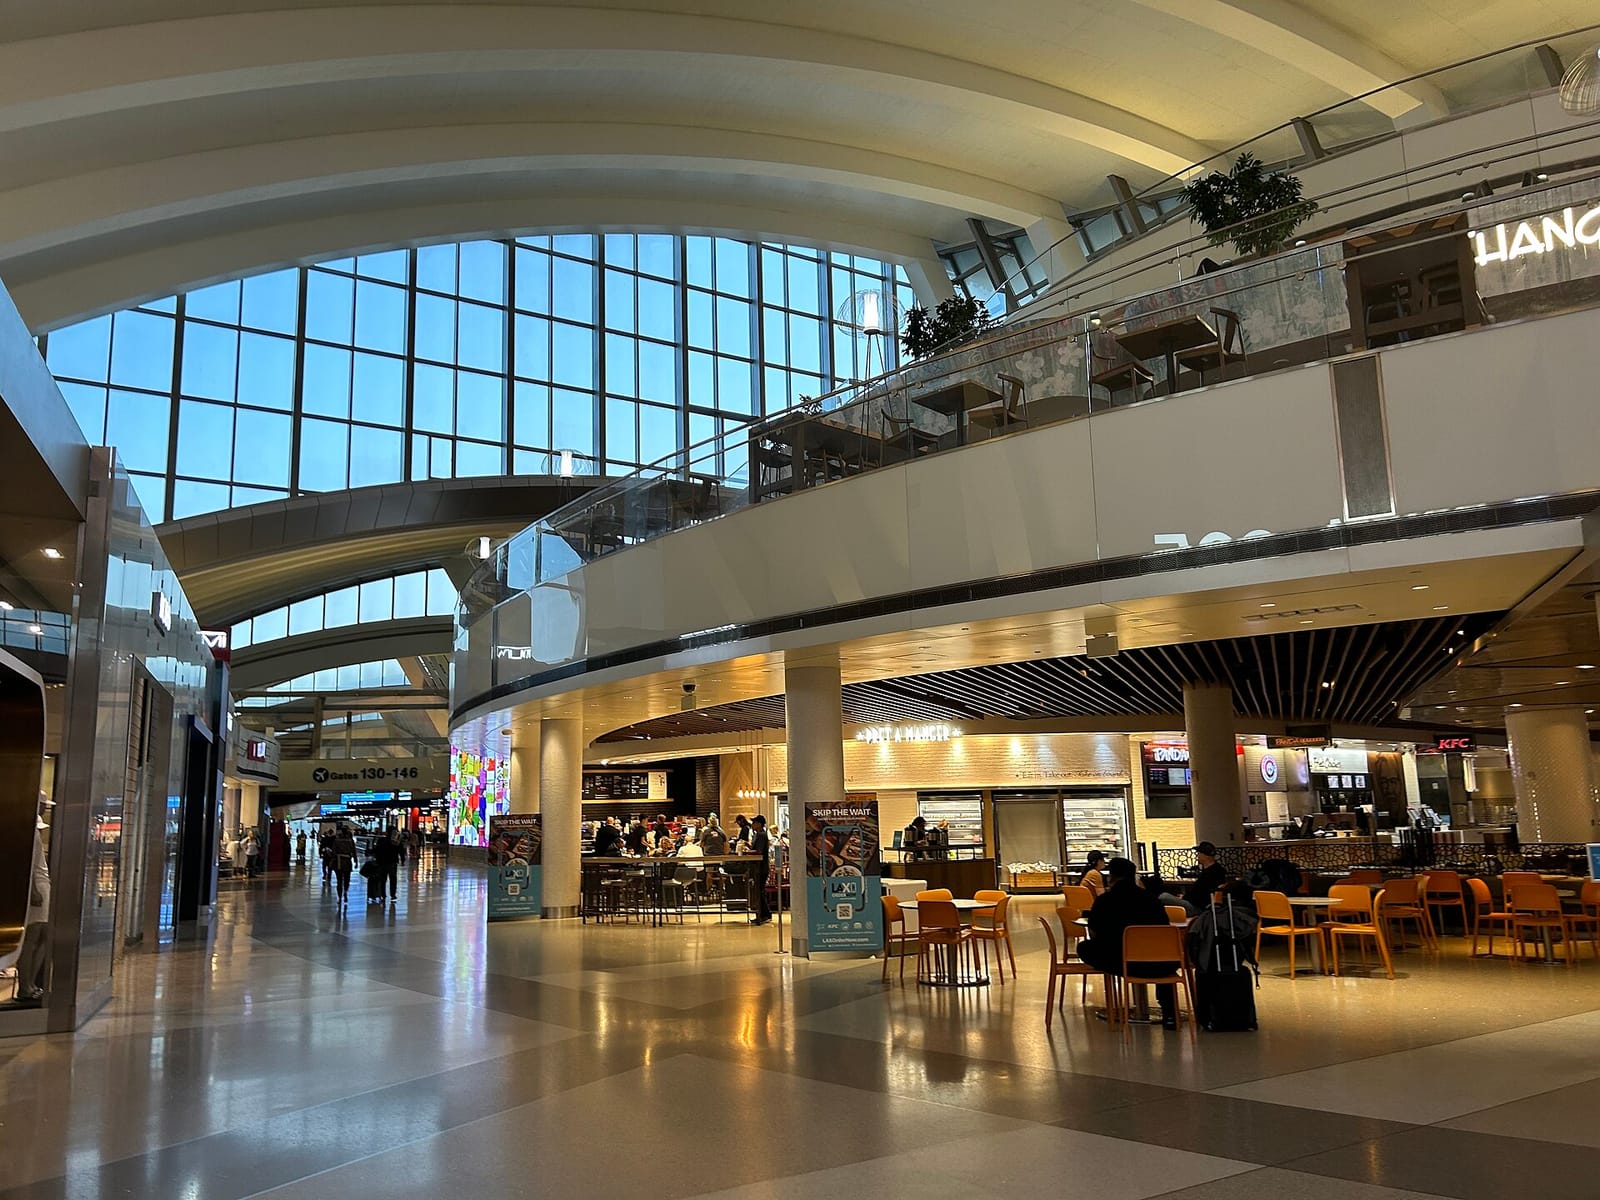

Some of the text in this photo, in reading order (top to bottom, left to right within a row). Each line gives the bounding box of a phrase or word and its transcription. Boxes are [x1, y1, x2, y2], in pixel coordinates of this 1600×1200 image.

[1438, 738, 1470, 749] KFC
[1152, 747, 1190, 761] PANDA
[330, 767, 418, 780] Gates 130-146
[849, 808, 871, 816] WAIT
